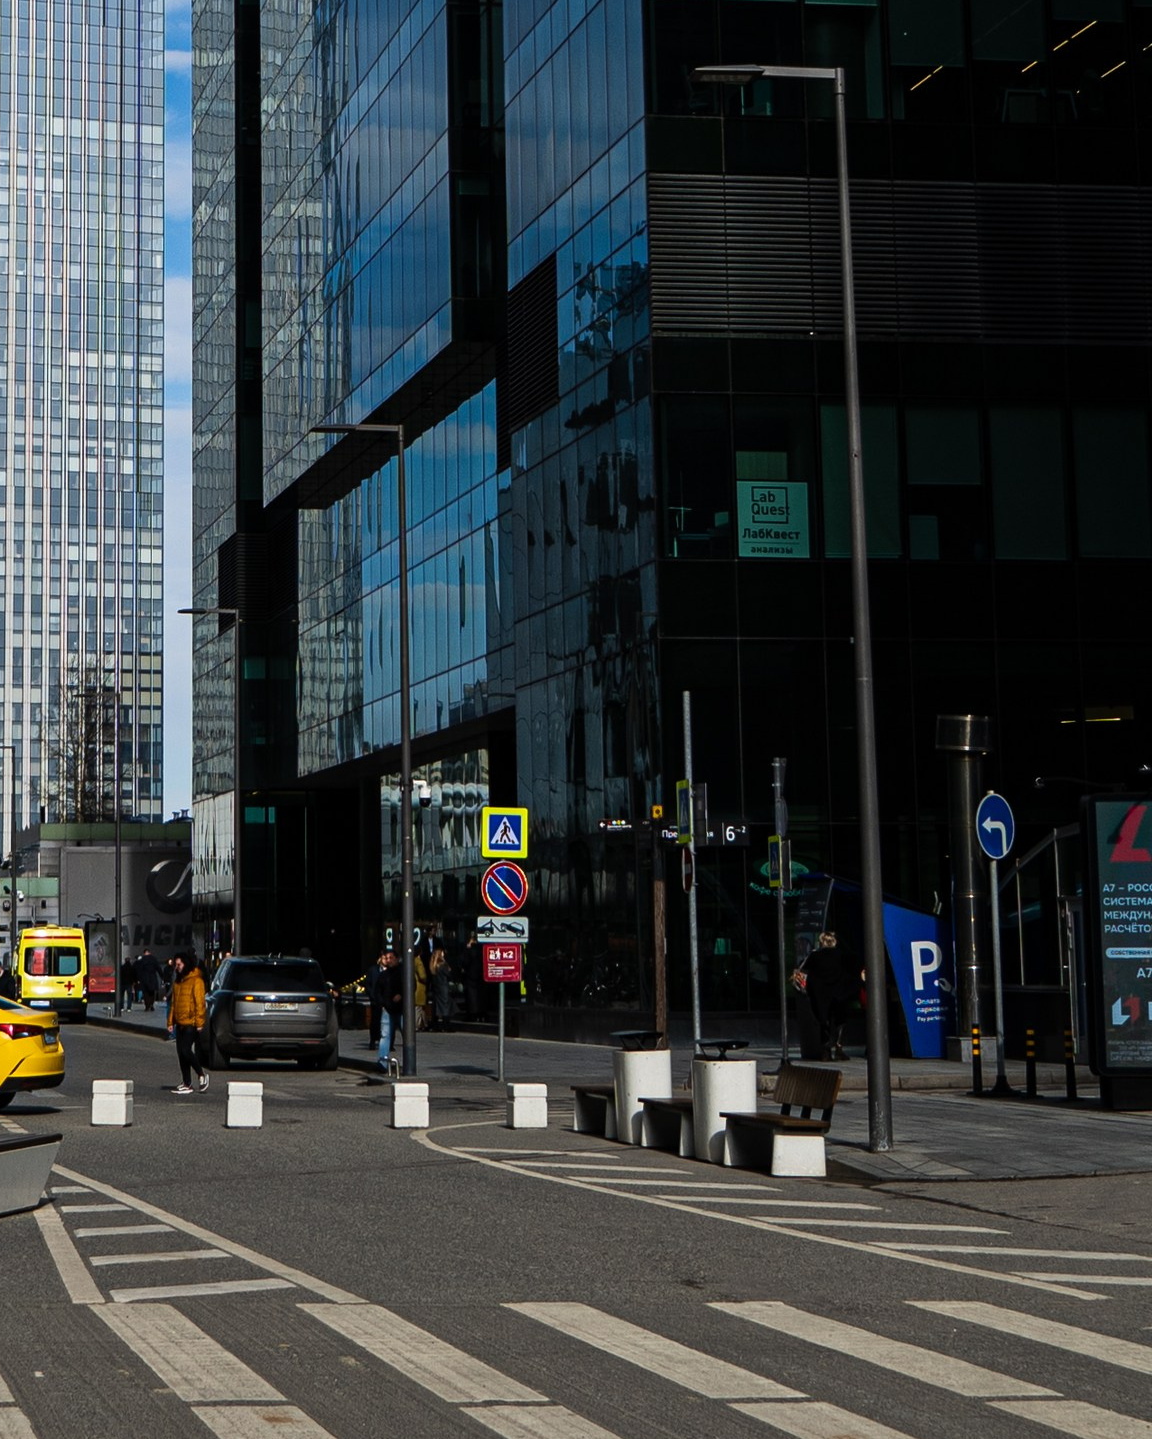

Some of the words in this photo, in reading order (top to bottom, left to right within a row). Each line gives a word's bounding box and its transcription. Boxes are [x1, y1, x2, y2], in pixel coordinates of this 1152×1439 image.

[751, 490, 776, 502] Lab
[751, 503, 790, 515] Quest
[742, 528, 800, 540] ЛабКвест
[750, 546, 793, 554] анализы
[1103, 897, 1152, 906] СИСТЕМА
[1103, 910, 1152, 921] МЕЖДУН
[1104, 922, 1152, 933] РАСЧЁТО
[910, 940, 943, 991] P
